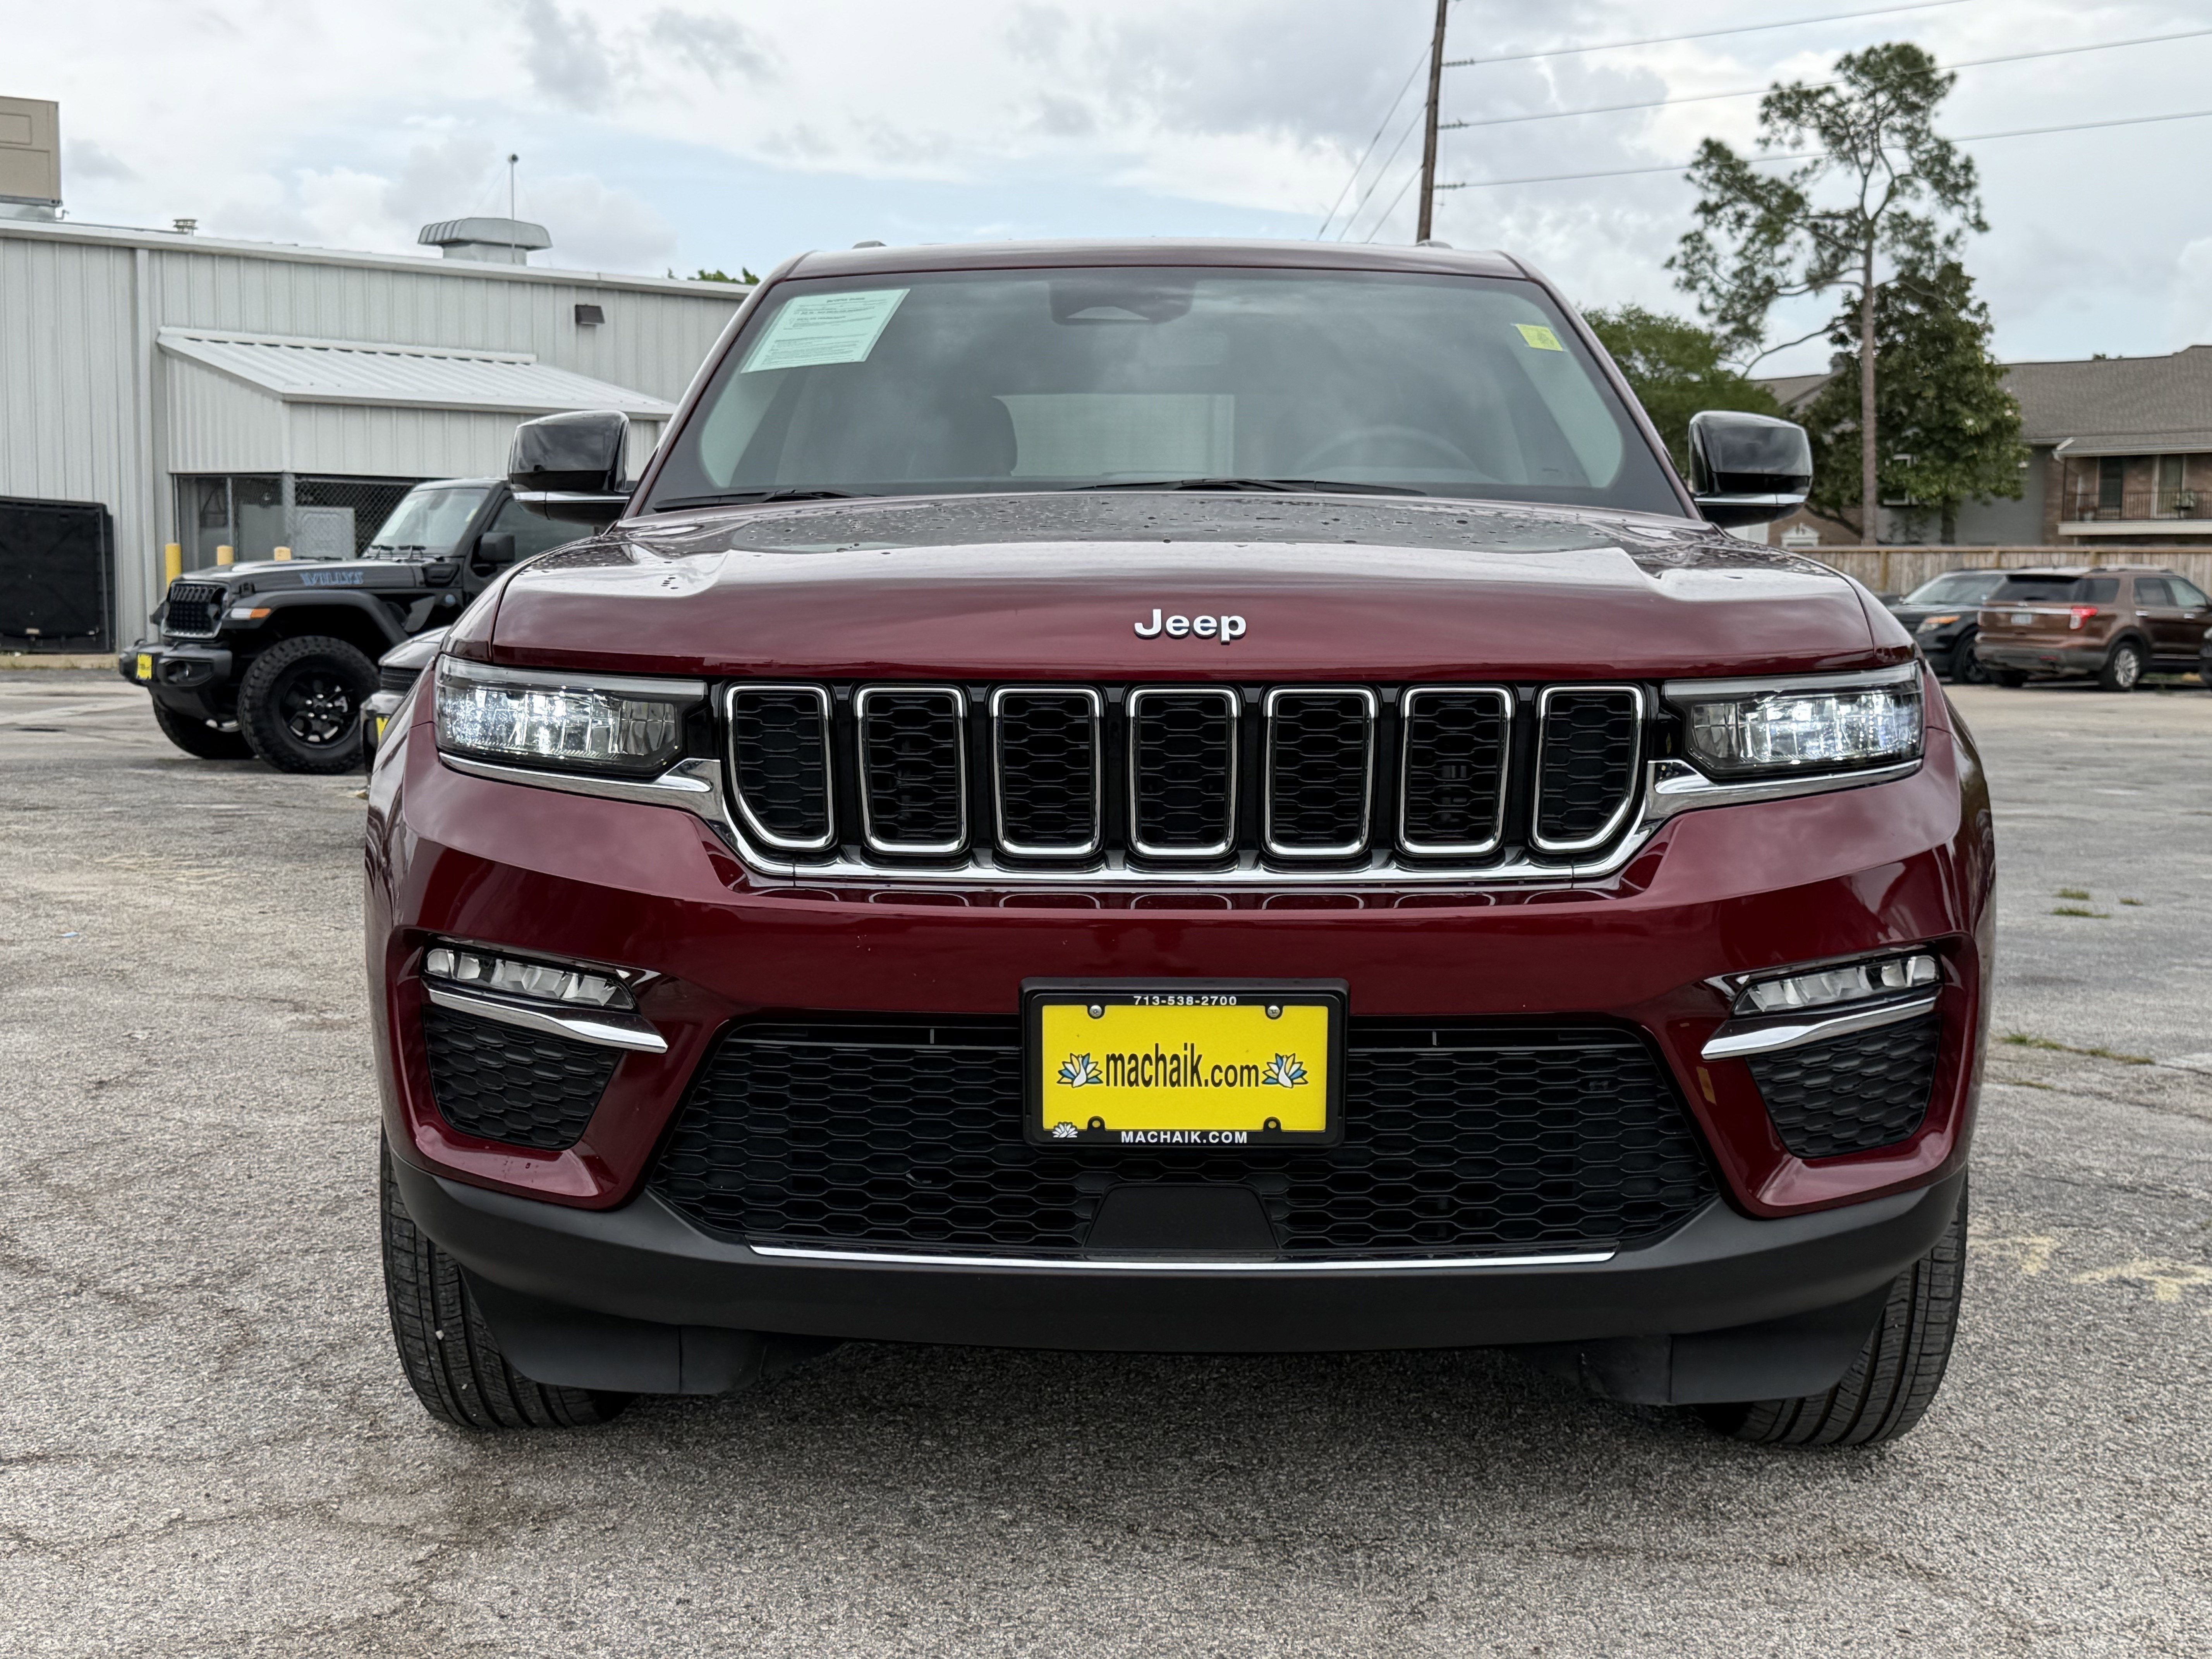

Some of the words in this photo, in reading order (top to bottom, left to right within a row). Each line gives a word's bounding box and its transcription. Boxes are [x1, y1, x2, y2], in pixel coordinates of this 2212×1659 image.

[300, 571, 363, 586] WILLYS
[1134, 609, 1247, 645] Jeep
[1133, 996, 1237, 1005] 713-538-2700
[1106, 1042, 1259, 1087] machaik.com
[1121, 1131, 1247, 1144] MACHAIK.COM
